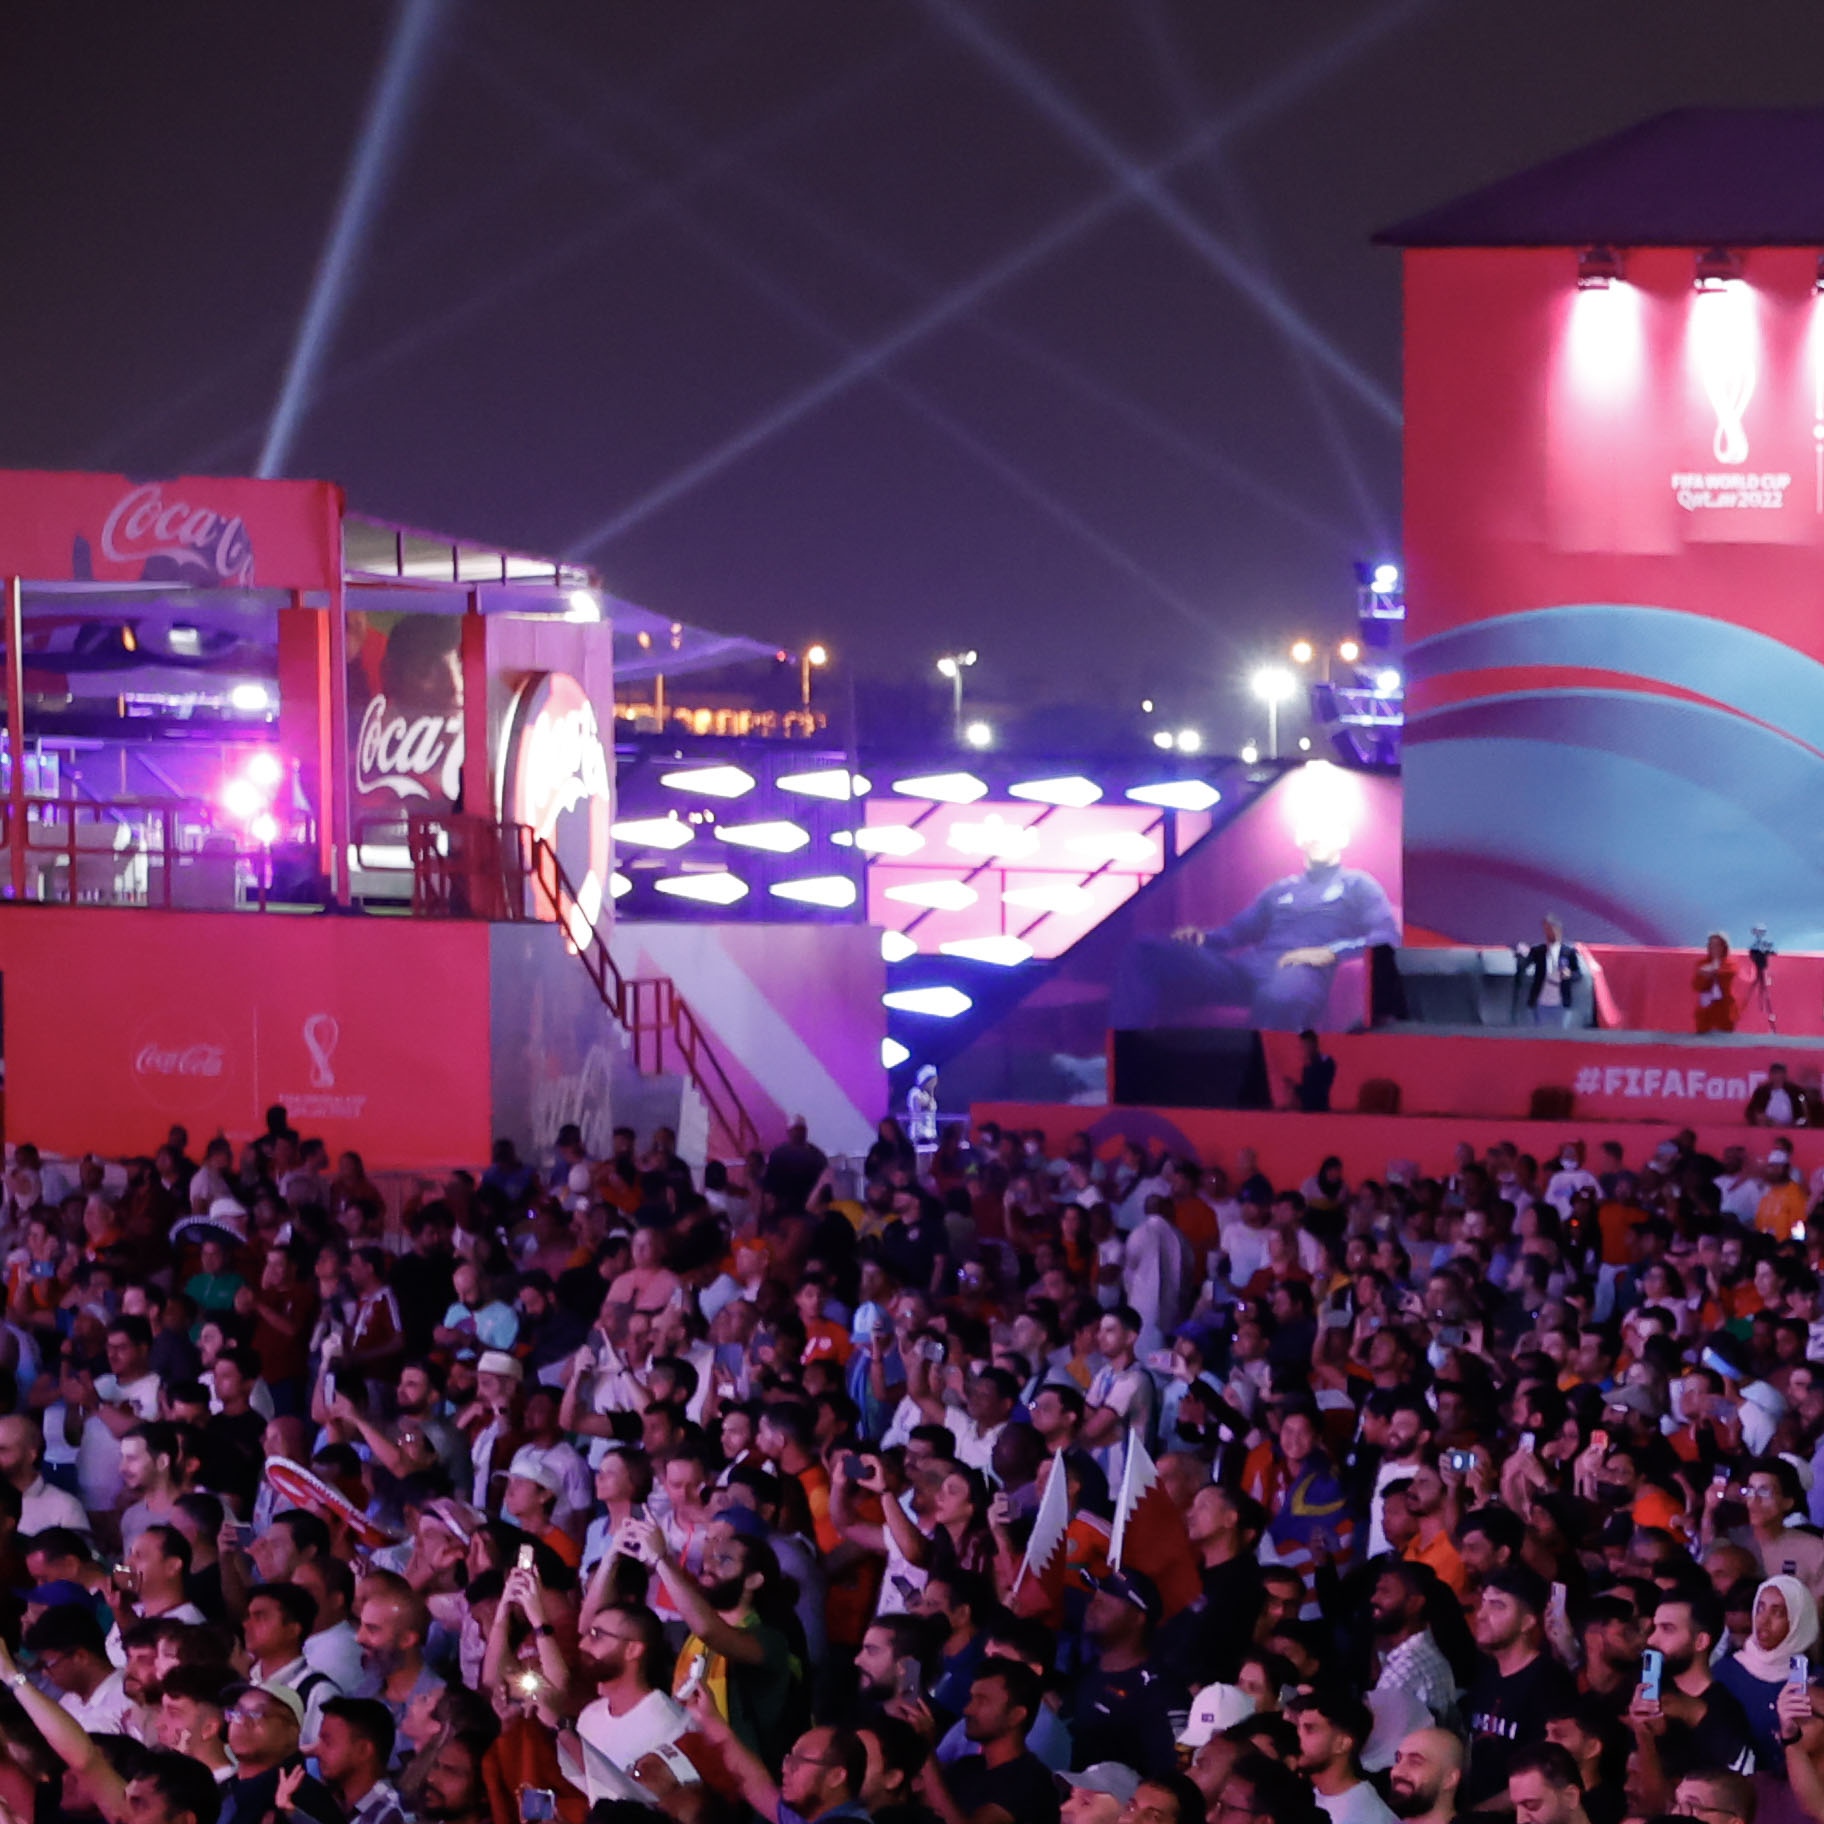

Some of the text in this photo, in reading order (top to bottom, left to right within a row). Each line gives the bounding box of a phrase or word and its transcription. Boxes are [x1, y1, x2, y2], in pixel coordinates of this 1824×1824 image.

[1671, 473, 1791, 490] FIFA WORLD CUP
